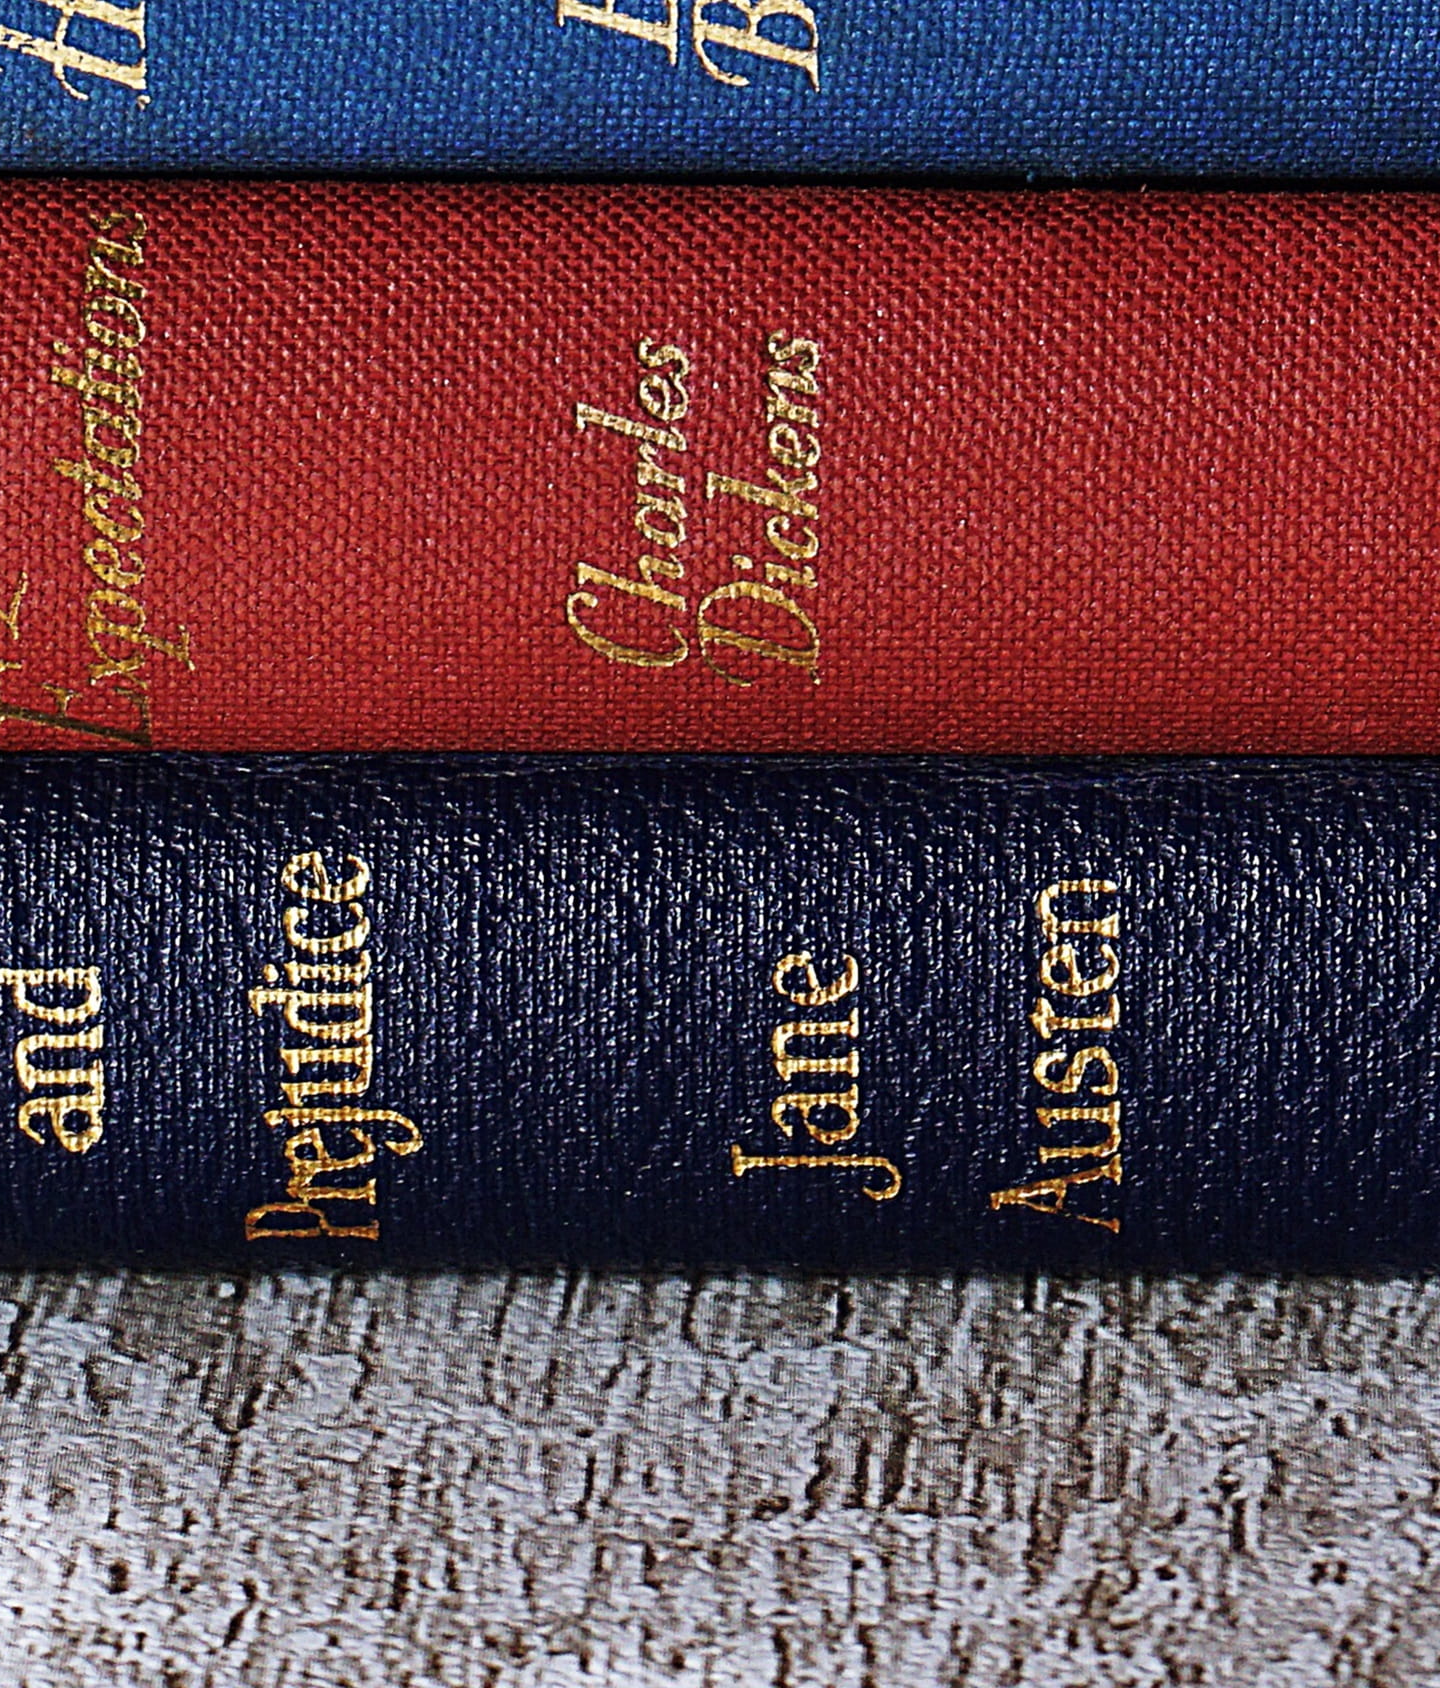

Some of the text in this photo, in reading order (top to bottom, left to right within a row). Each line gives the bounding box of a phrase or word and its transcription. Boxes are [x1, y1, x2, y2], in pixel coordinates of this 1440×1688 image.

[566, 336, 689, 667] Charles
[698, 330, 821, 685] Dickens
[245, 850, 423, 1242] Prejudice
[731, 950, 902, 1201] Jane
[989, 878, 1121, 1234] Austen
